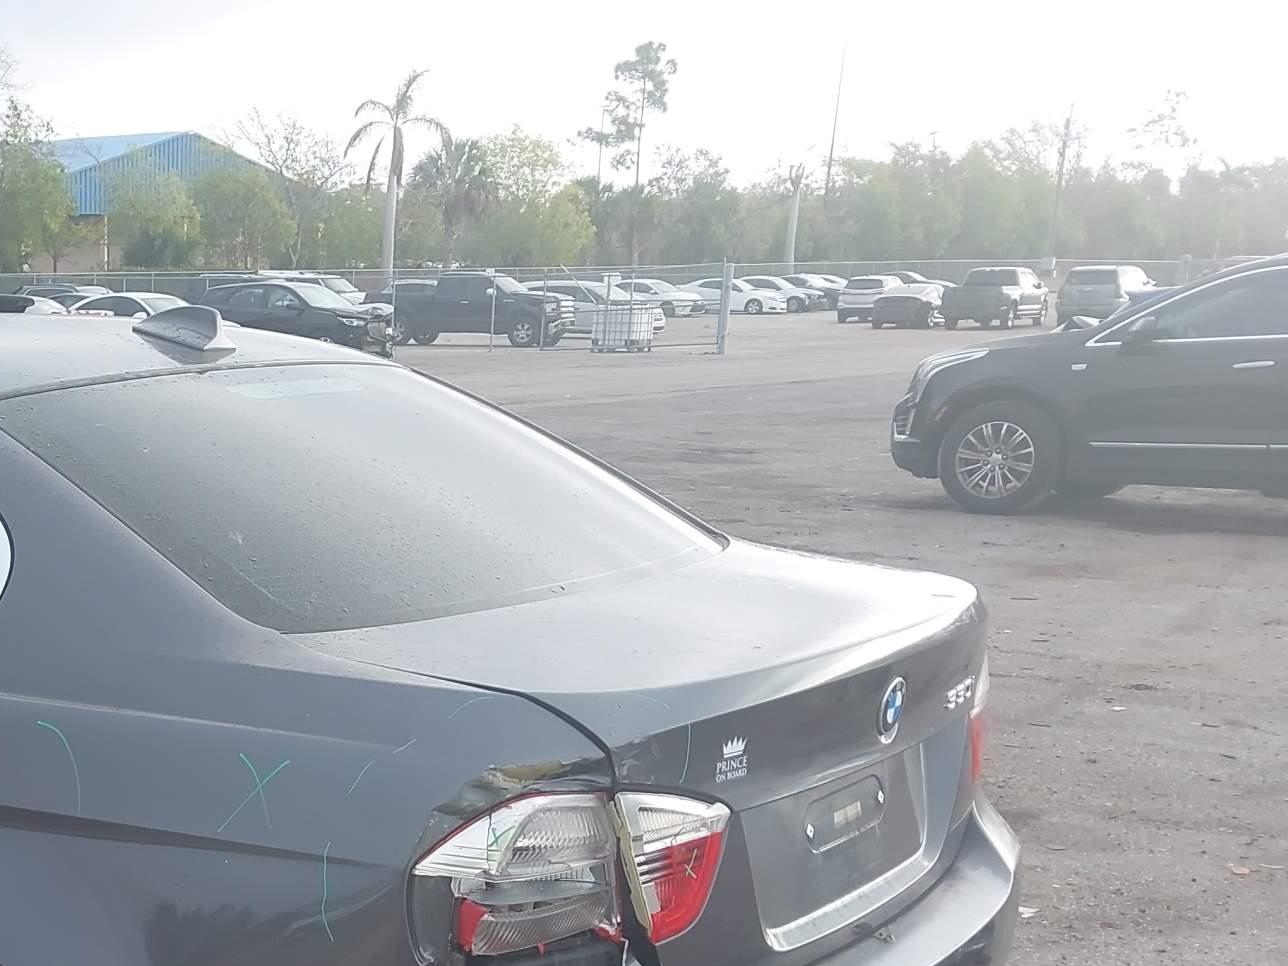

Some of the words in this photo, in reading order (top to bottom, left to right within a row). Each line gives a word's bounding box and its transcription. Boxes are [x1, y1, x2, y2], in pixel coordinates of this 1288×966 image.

[716, 755, 748, 774] PRINCE
[715, 773, 726, 783] ON
[727, 767, 748, 780] BOARD
